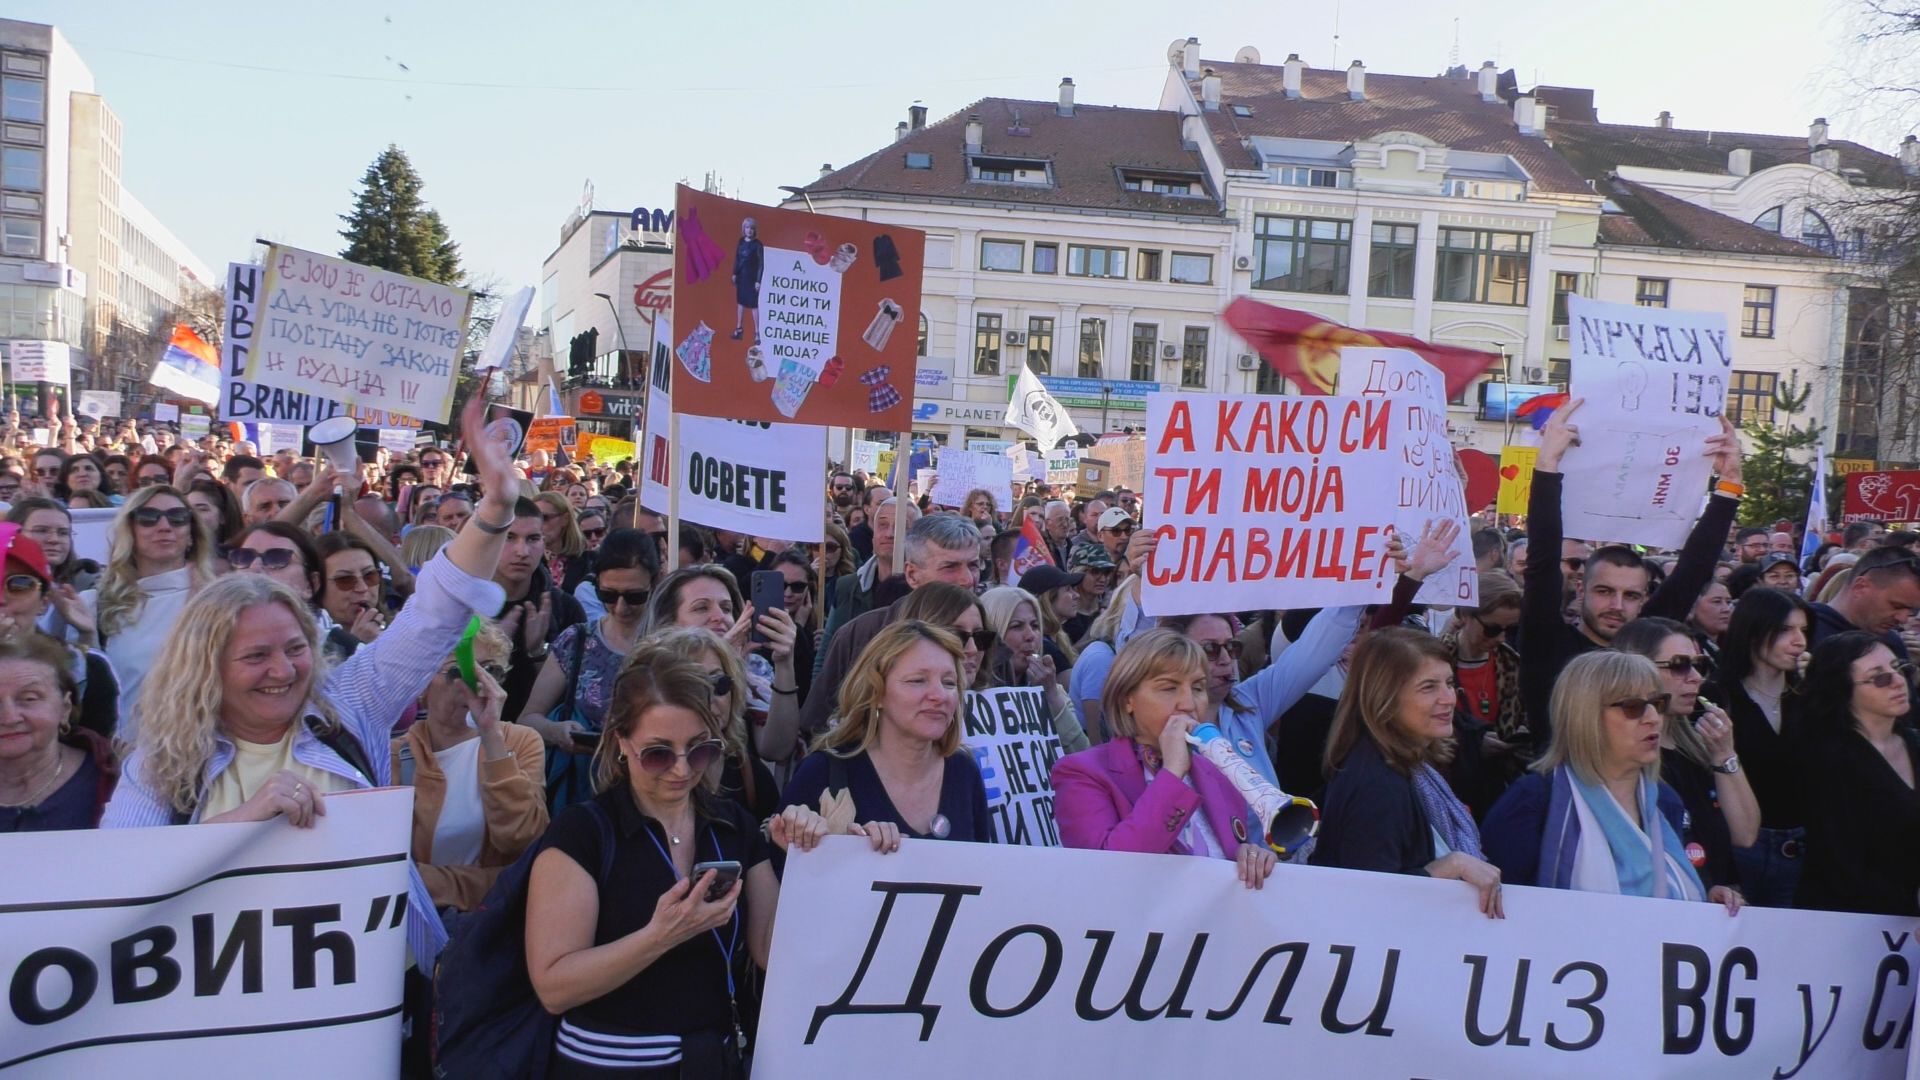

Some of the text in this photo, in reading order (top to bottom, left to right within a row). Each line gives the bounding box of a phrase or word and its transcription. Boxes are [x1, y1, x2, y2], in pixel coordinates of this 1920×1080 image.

[370, 280, 453, 318] ОСТАЛО
[767, 292, 831, 311] ЛИ СИ ТИ
[771, 275, 829, 294] КОЛИКО
[270, 288, 312, 316] ДА
[403, 317, 462, 350] МОТКЕ
[764, 326, 830, 345] СЛАВИЦЕ
[768, 309, 828, 328] РАДИЛА,
[271, 317, 374, 359] ПОСТАНУ
[380, 343, 450, 377] ЗАКОН
[773, 343, 819, 360] МОЈА?
[296, 356, 386, 397] СУДИЈА
[1157, 400, 1196, 453] А
[1215, 400, 1328, 454] КАКО
[1339, 399, 1392, 453] СИ
[1154, 467, 1222, 515] ТИ
[1147, 524, 1396, 589] СЛАВИЦЕ?
[803, 879, 1401, 1046] Дошли
[1461, 953, 1609, 1052] из
[1661, 942, 1758, 1057] BG
[1773, 983, 1843, 1080] у
